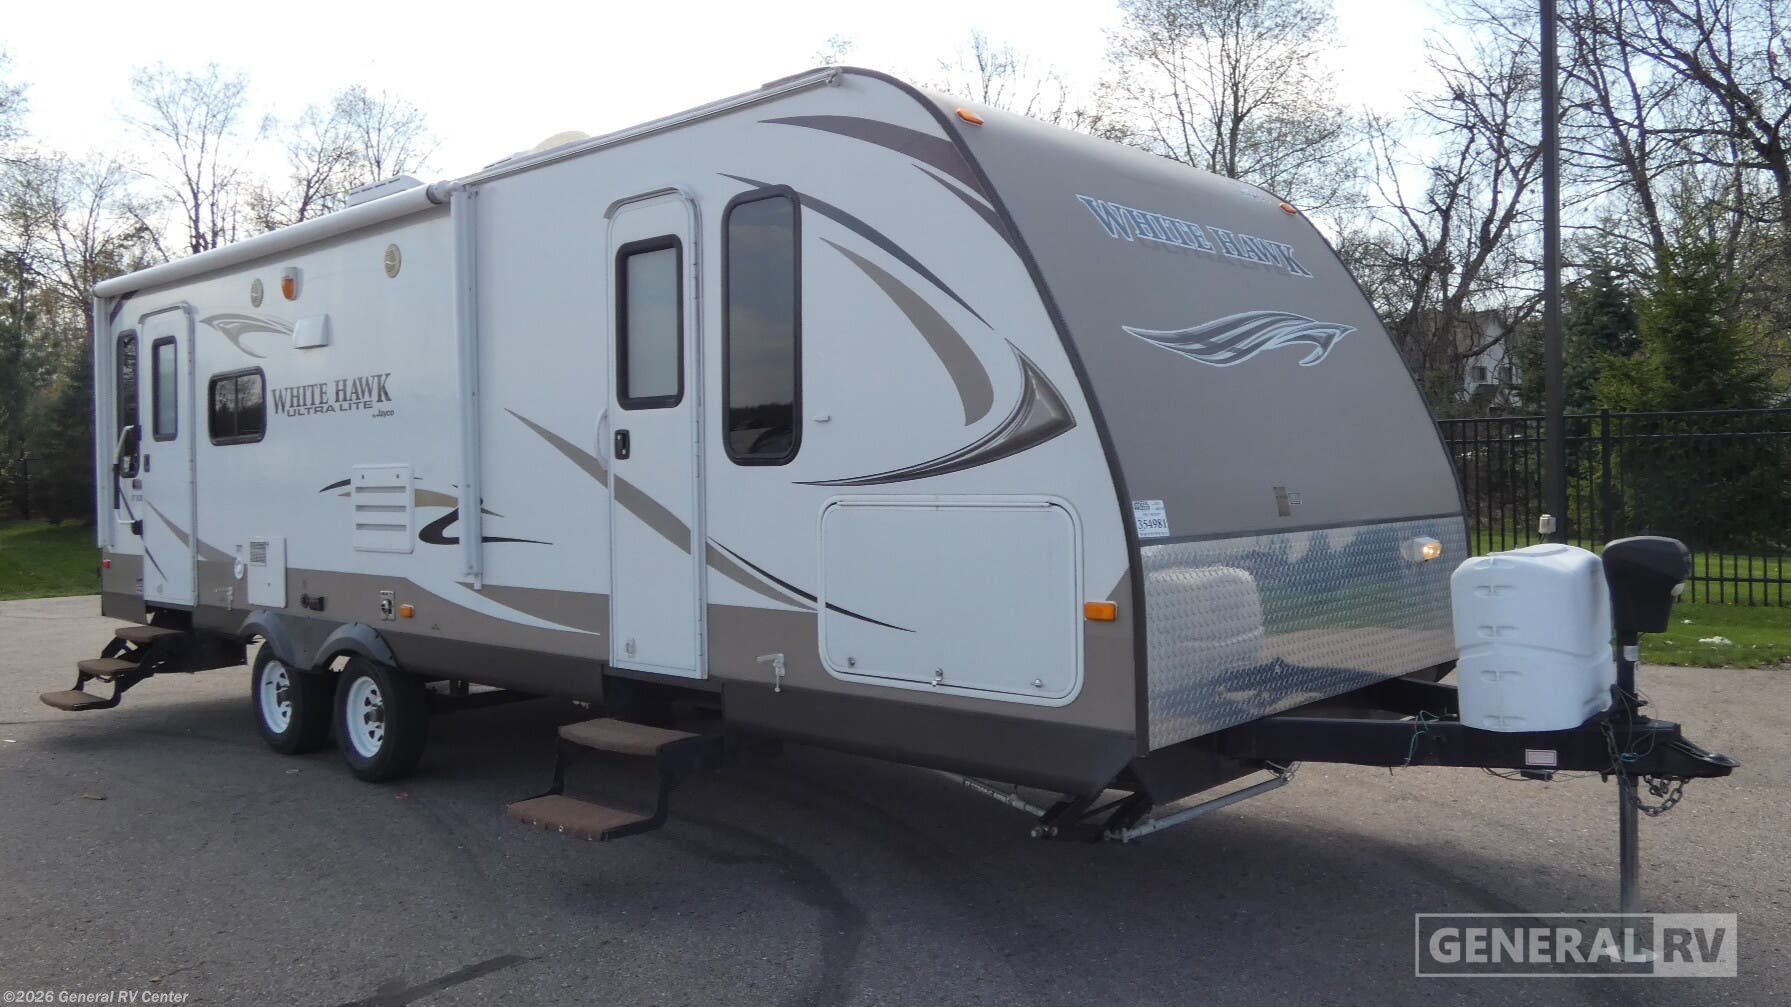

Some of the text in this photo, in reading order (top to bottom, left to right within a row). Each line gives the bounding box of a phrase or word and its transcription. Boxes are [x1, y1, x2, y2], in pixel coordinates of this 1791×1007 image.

[1074, 193, 1314, 278] WHITE HAWK
[271, 373, 393, 415] WHITE HAWK
[286, 400, 374, 417] ULTRA LITE
